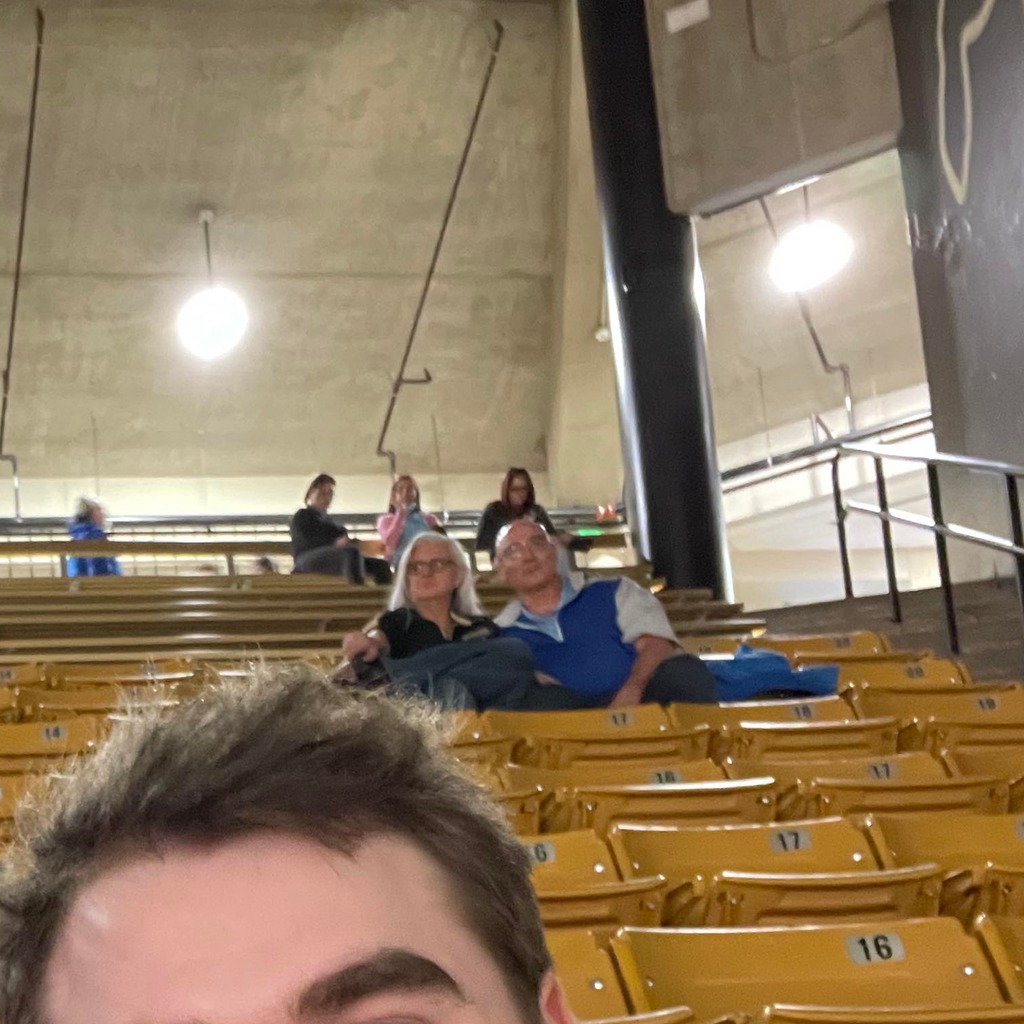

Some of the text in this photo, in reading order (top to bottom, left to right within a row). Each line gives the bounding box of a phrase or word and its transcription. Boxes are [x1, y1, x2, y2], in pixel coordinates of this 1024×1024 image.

[45, 726, 61, 740] 14
[872, 763, 891, 779] 17
[777, 831, 800, 851] 17
[857, 934, 894, 962] 16
